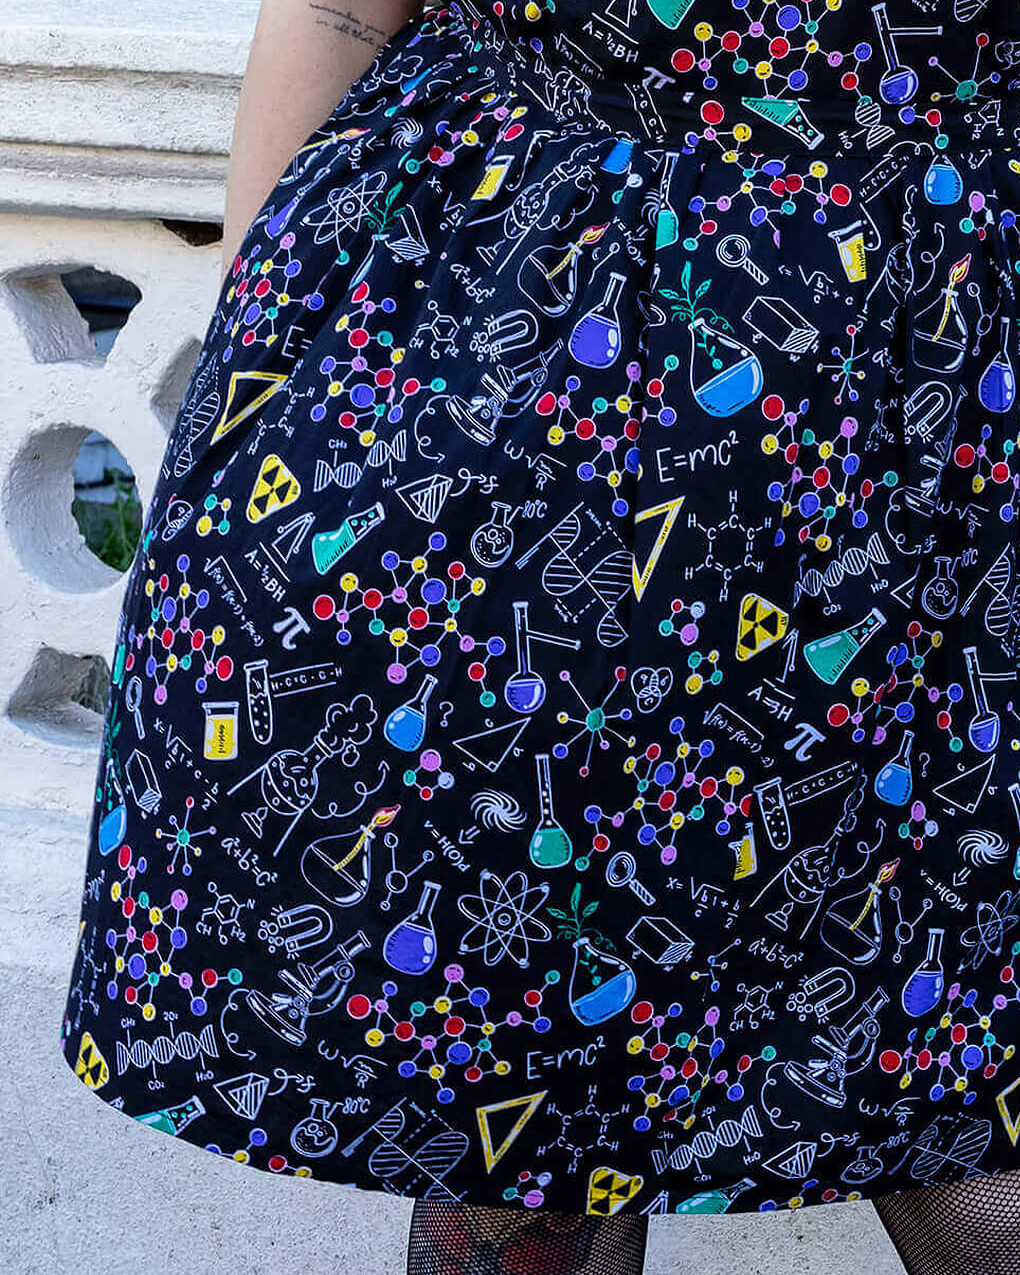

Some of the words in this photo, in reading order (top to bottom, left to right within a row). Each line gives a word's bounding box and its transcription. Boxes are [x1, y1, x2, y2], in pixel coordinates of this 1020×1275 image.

[655, 430, 740, 483] E=mc²
[272, 606, 311, 650] π
[439, 701, 454, 727] ?
[783, 722, 826, 762] π
[918, 752, 931, 778] ?
[246, 898, 256, 910] N
[774, 981, 784, 990] N
[527, 1035, 606, 1080] E=mc²
